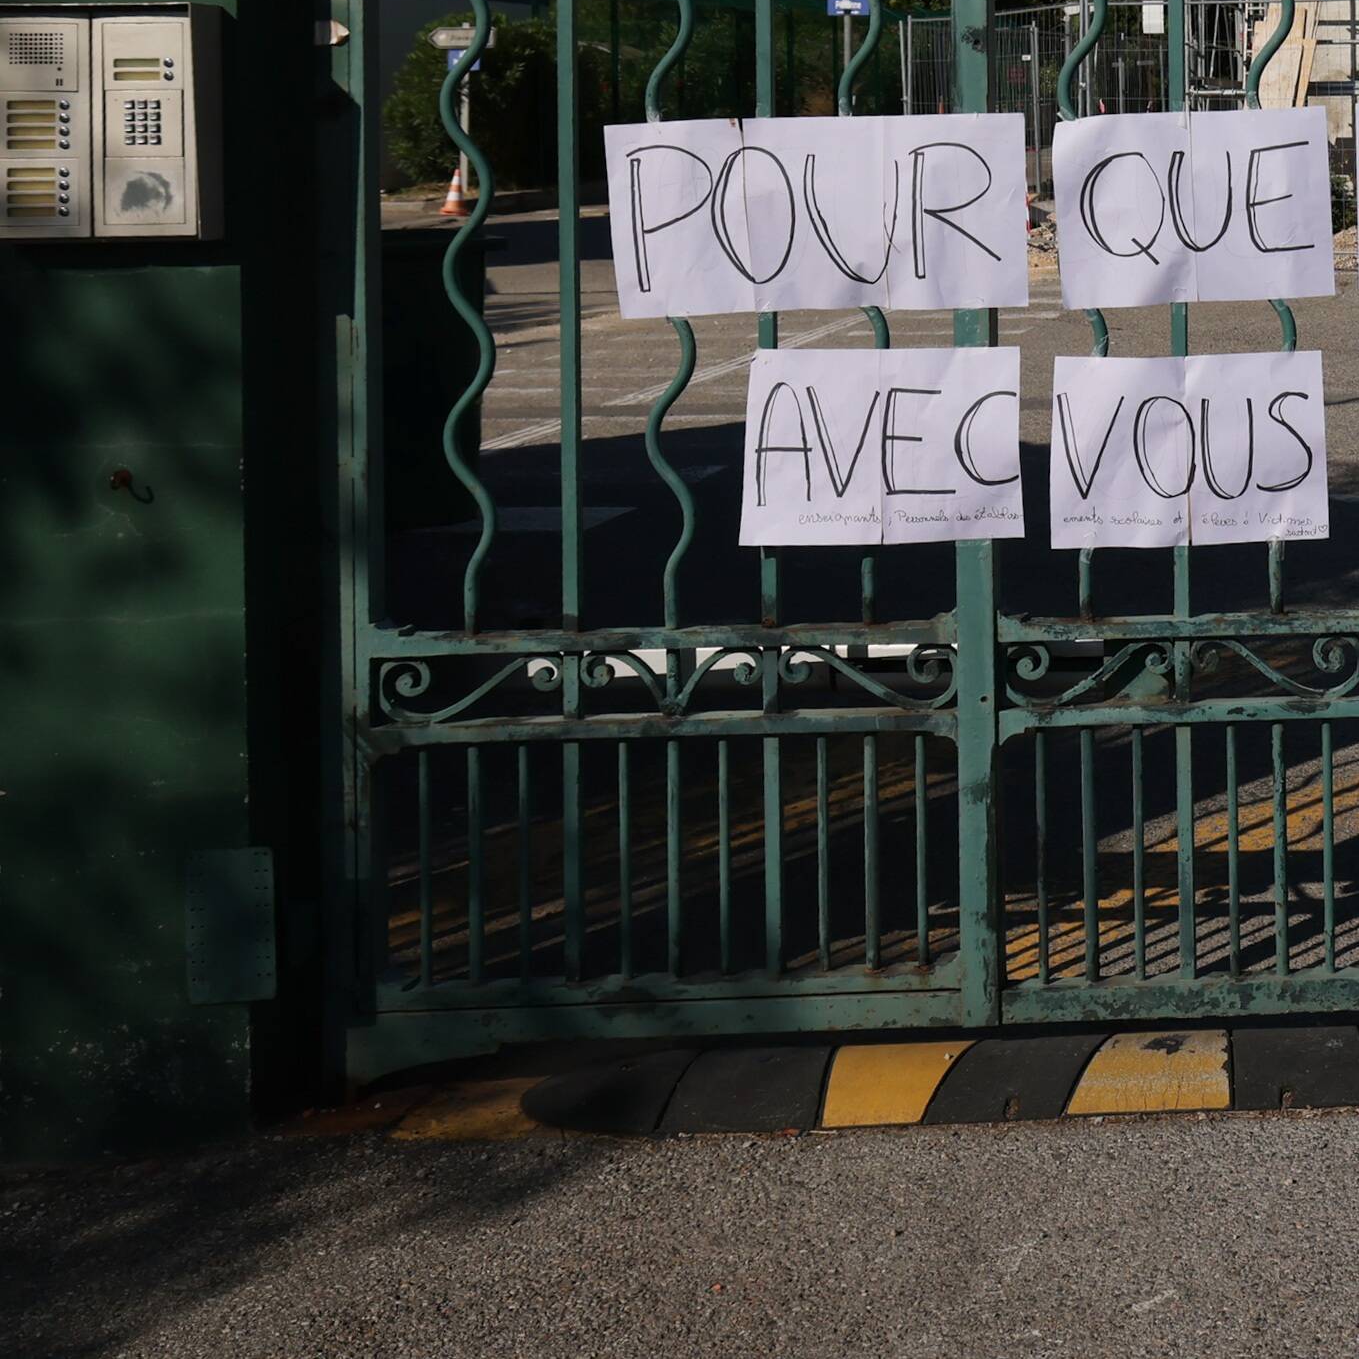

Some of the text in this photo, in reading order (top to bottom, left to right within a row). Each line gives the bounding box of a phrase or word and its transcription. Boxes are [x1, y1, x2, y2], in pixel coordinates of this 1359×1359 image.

[626, 142, 1002, 293] POUR
[1080, 140, 1316, 265] QUE
[754, 381, 1314, 507] AVEC VOUS
[1172, 510, 1183, 523] et
